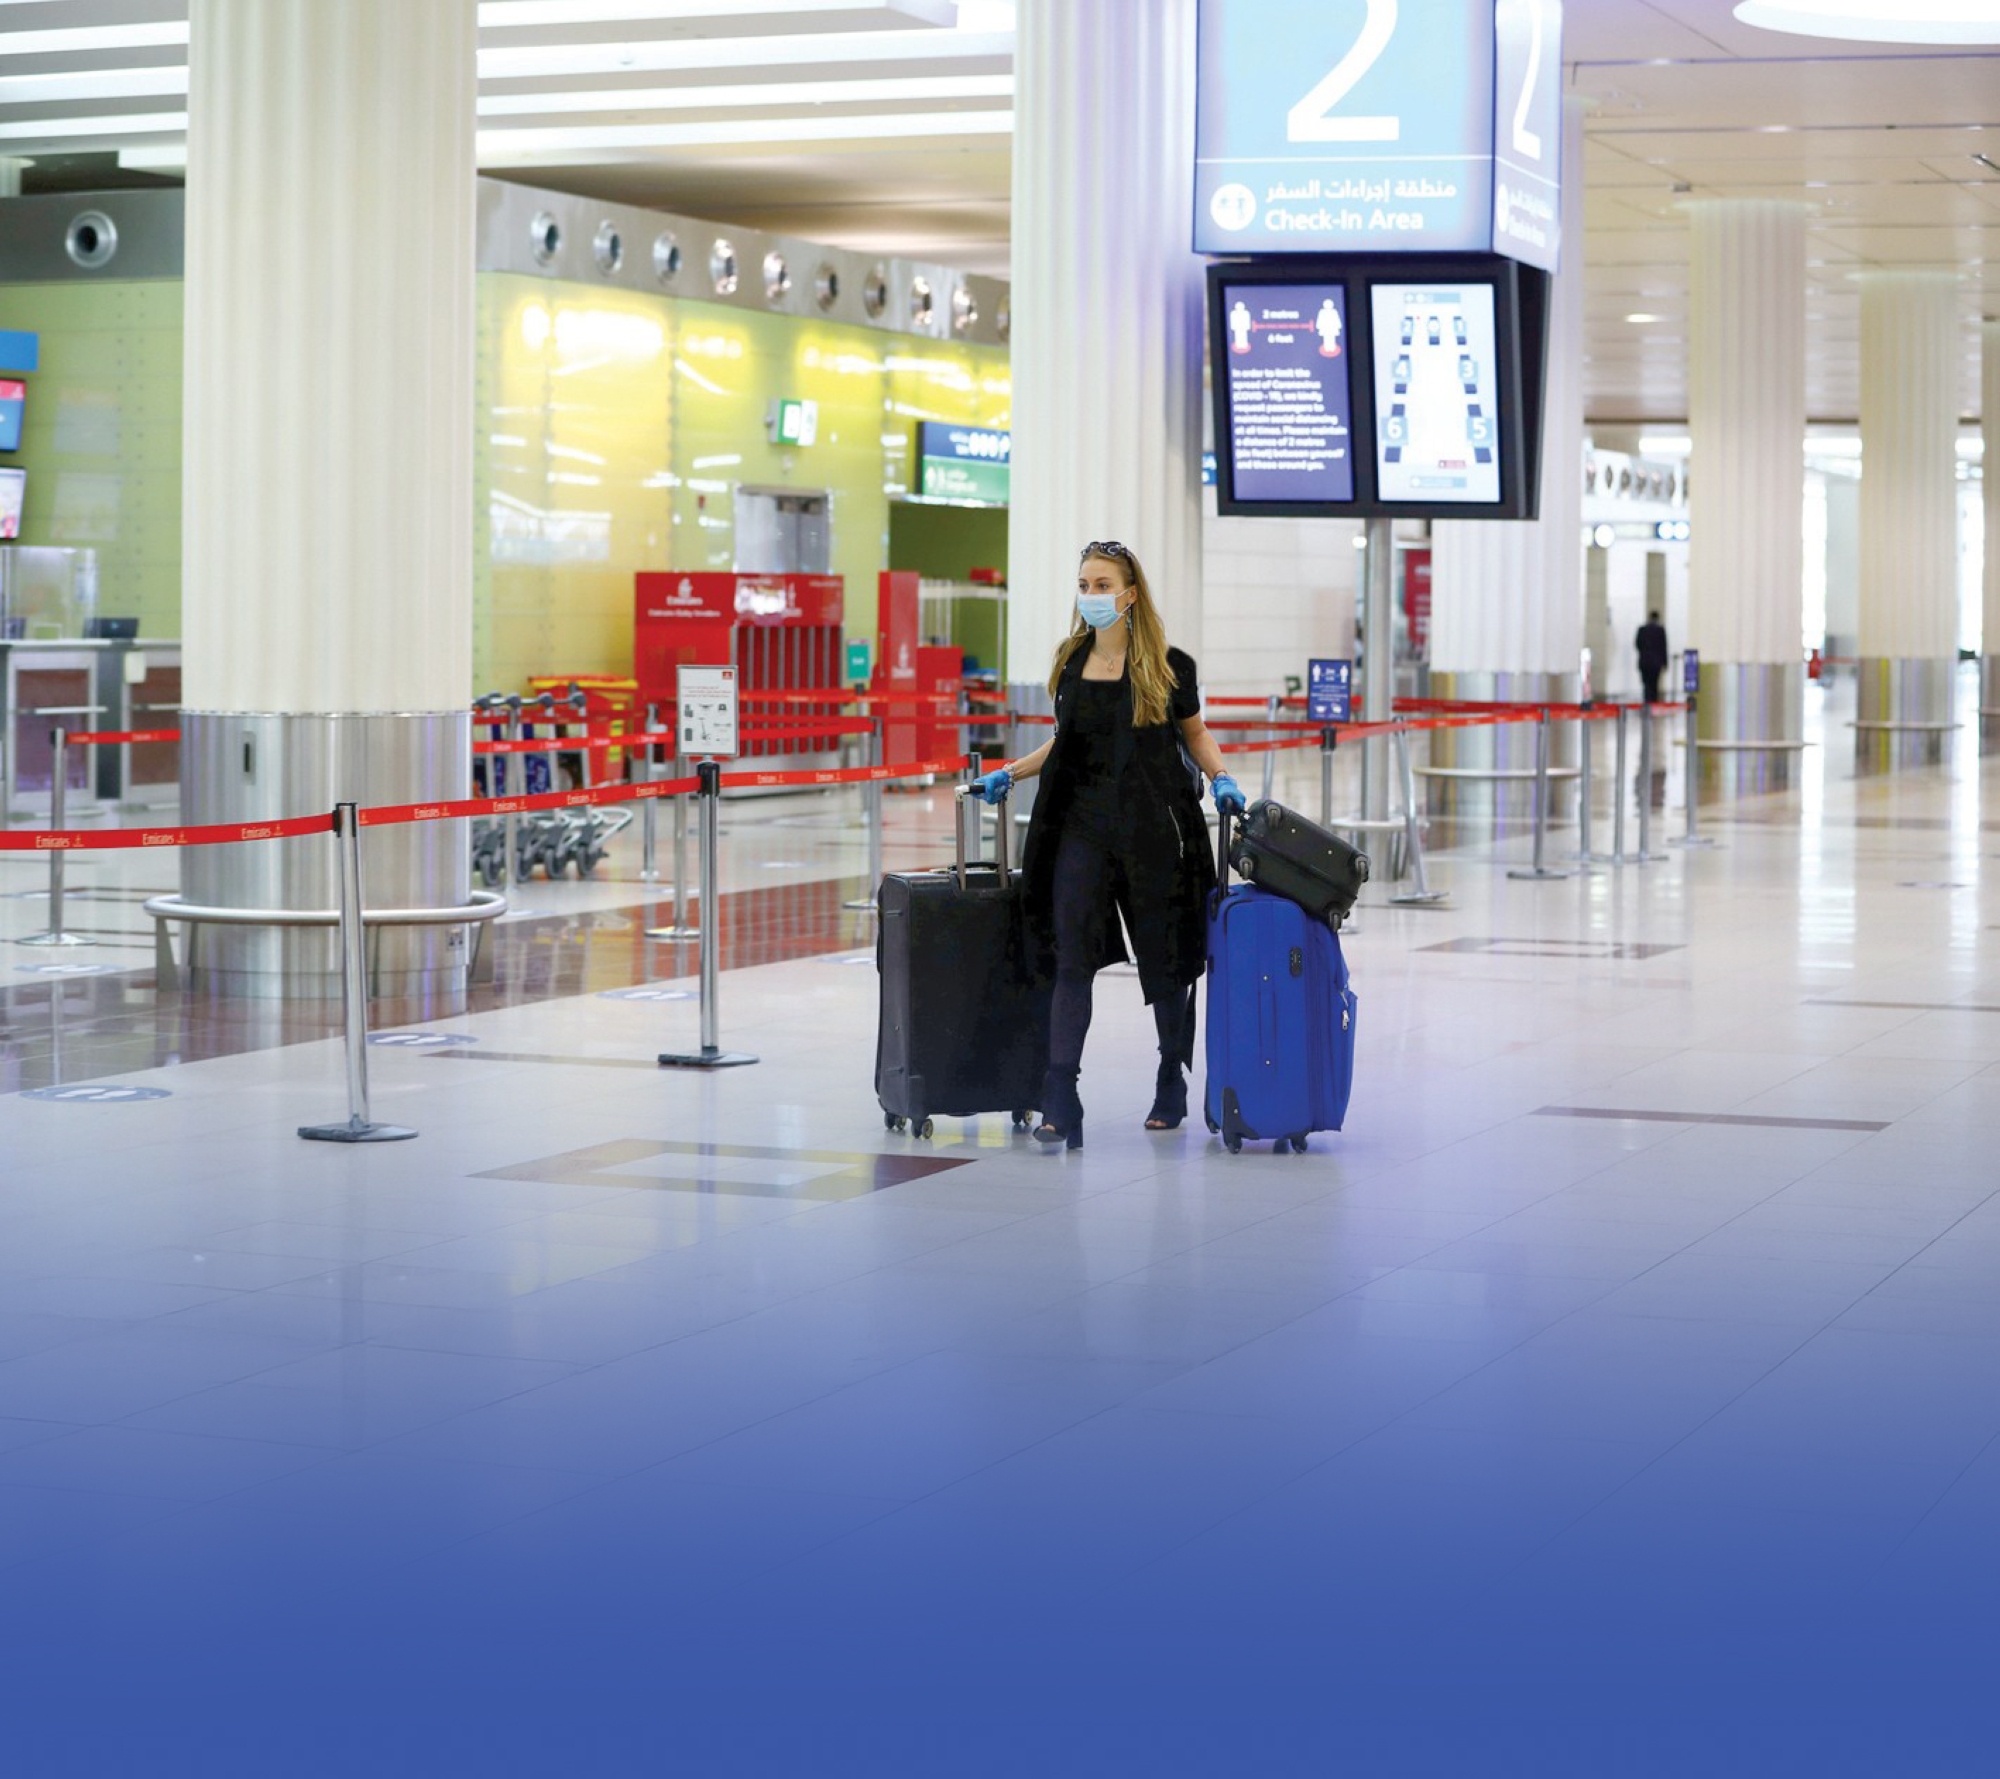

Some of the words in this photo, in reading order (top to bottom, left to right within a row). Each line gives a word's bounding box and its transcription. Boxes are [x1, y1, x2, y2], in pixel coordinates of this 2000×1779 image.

[1288, 0, 1400, 142] 2
[1265, 181, 1320, 203] السفر
[1324, 178, 1389, 203] إجراءات
[1394, 178, 1457, 200] منطقة
[1265, 207, 1362, 231] Check-In
[1368, 208, 1424, 231] Area
[1275, 333, 1294, 343] feet
[1241, 368, 1263, 378] order
[1295, 368, 1311, 378] the
[1394, 360, 1407, 378] 4
[1463, 360, 1474, 378] 3
[1232, 379, 1261, 390] spread
[1272, 379, 1322, 390] Coronavirus
[1233, 403, 1265, 414] request
[1266, 403, 1312, 414] passengers
[1233, 414, 1269, 425] maintain
[1270, 414, 1294, 425] social
[1295, 414, 1338, 425] distancing
[1246, 425, 1255, 436] all
[1282, 425, 1310, 436] Please
[1311, 425, 1348, 436] maintain
[1387, 417, 1403, 440] 6
[1473, 417, 1487, 440] 5
[1242, 437, 1277, 447] distance
[1295, 437, 1326, 447] metres
[1273, 447, 1309, 460] between
[1309, 447, 1345, 460] yourself
[1236, 459, 1252, 471] and
[1253, 459, 1277, 471] those
[1278, 459, 1307, 471] around
[493, 800, 517, 812] Emirates
[414, 808, 440, 819] Emirates
[142, 833, 175, 846] Emirates
[241, 827, 271, 841] Emirates
[35, 835, 70, 848] Emirates
